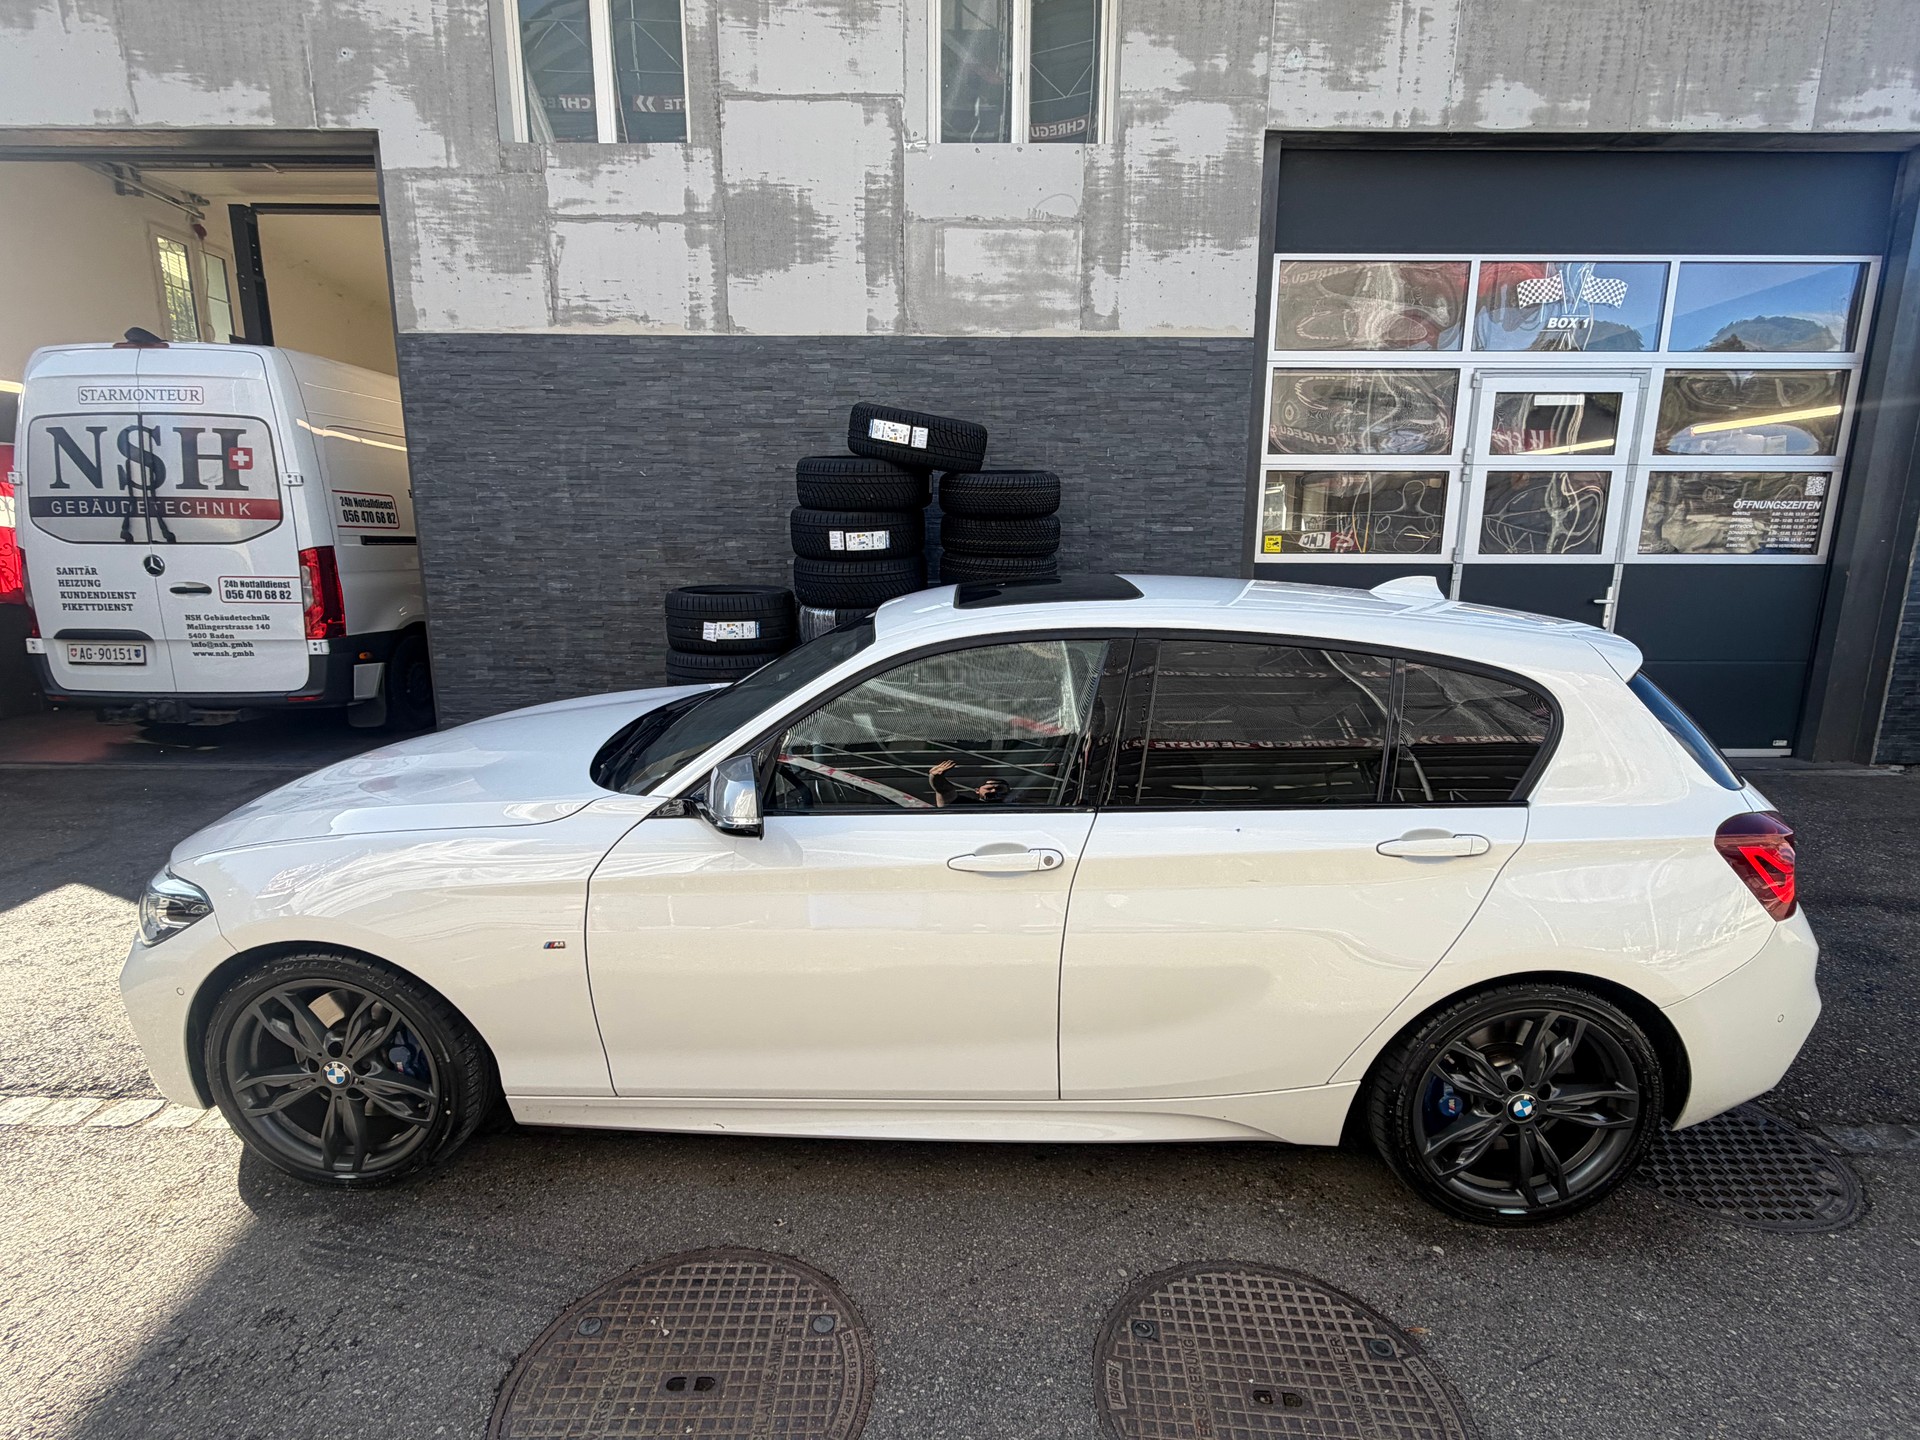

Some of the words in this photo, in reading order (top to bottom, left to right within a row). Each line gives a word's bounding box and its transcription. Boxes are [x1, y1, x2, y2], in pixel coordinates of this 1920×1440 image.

[1547, 317, 1578, 329] BOX
[1582, 317, 1590, 328] 1
[80, 388, 200, 402] STARMONTEUR
[46, 425, 250, 491] NSH
[1733, 498, 1822, 510] ÖFFNUNGSZEITEN
[342, 509, 360, 523] 056
[361, 510, 375, 523] 470
[375, 512, 387, 524] 68
[386, 512, 397, 524] 82
[56, 566, 98, 576] SANITÄR
[57, 579, 101, 588] HEIZUNG
[223, 580, 239, 588] 24h
[239, 580, 291, 589] Notfalldienst
[60, 591, 137, 600] KUNDENDIENST
[225, 590, 244, 600] 056
[246, 590, 263, 600] 470
[264, 590, 278, 600] 68
[279, 590, 292, 600] 82
[62, 603, 134, 612] PIKETTDIENST
[186, 623, 254, 632] Mellingerstrasse
[191, 641, 254, 650] info@nsh.gmbh
[192, 651, 255, 659] www.nsh.gmbh
